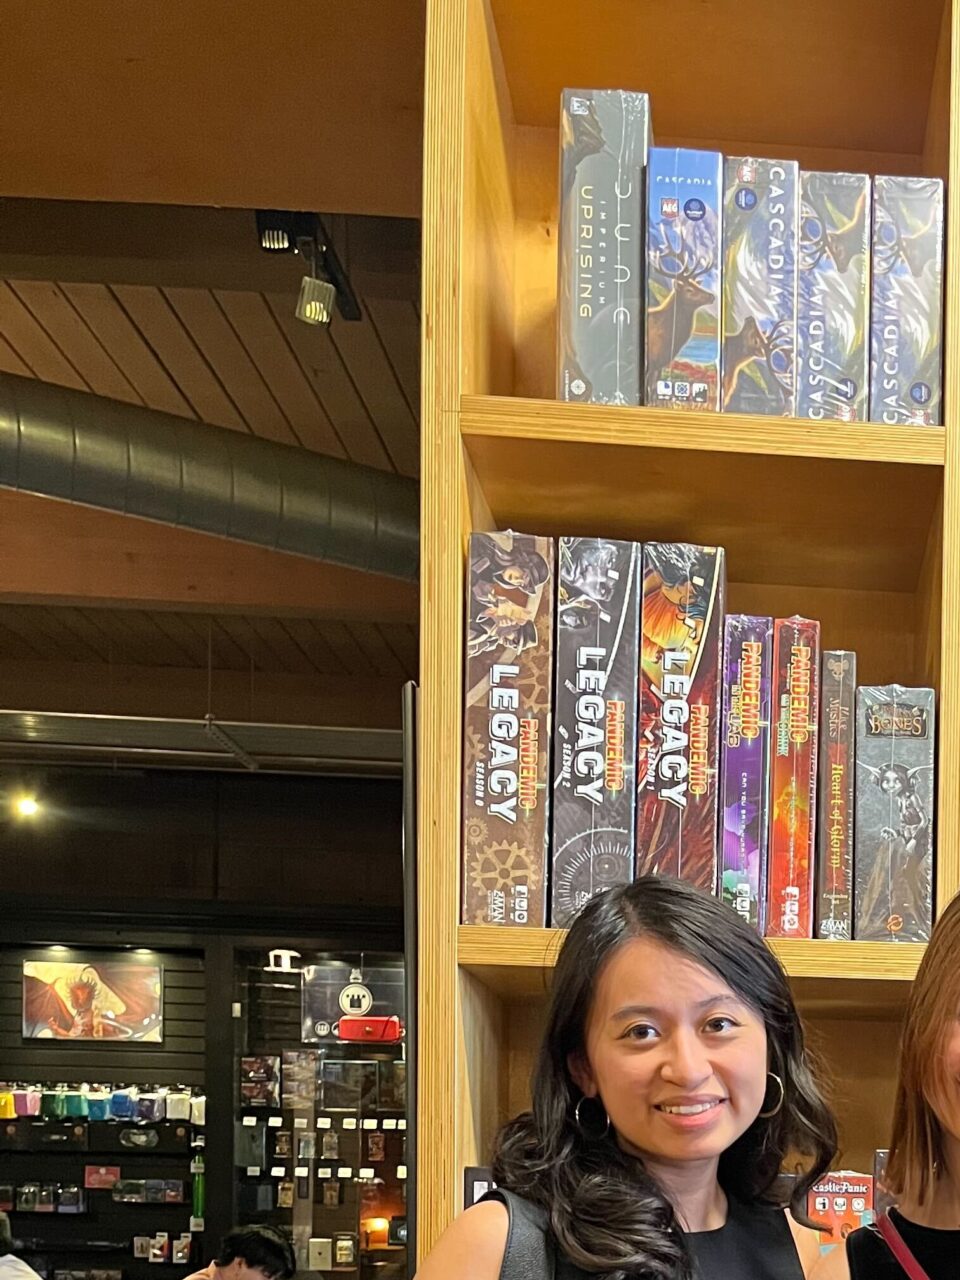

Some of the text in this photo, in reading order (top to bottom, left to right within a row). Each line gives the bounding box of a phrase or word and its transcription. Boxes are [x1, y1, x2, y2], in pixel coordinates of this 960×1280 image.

[579, 185, 595, 318] UPRISING
[599, 200, 607, 304] IMPERIUM
[768, 166, 786, 301] CASCADIA
[808, 292, 825, 420] CASCADIA
[882, 298, 899, 426] CASCADIA
[574, 645, 606, 806] LEGACY
[658, 651, 690, 809] LEGACY
[740, 641, 762, 739] PANDEMIC
[789, 645, 811, 743] PANDEMIC
[871, 715, 922, 735] BONES
[475, 761, 485, 798] SEASON
[487, 664, 520, 824] LEGACY
[518, 718, 539, 810] PANDEMIC
[562, 743, 572, 788] SEASON 2
[605, 700, 625, 791] PANDEMIC
[647, 748, 656, 782] SEASON
[688, 704, 709, 795] PANDEMIC
[830, 763, 844, 807] Heart
[842, 1181, 868, 1193] Panic
